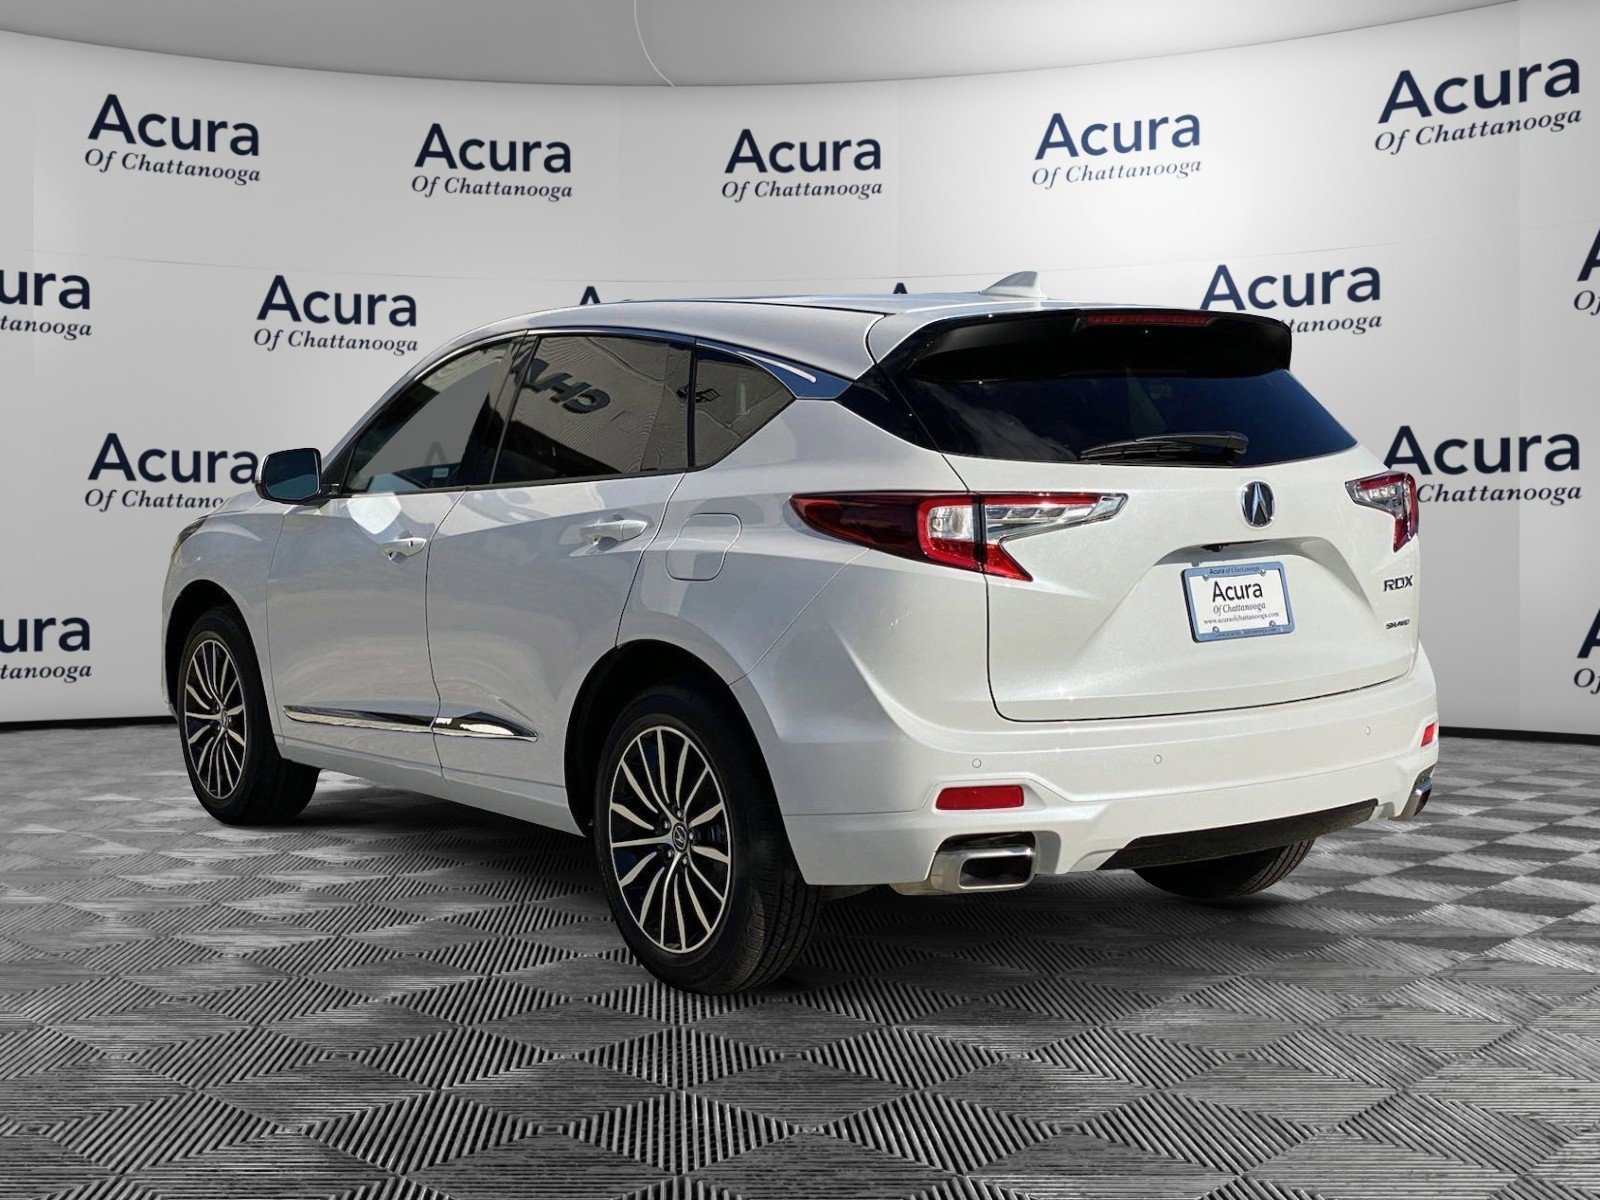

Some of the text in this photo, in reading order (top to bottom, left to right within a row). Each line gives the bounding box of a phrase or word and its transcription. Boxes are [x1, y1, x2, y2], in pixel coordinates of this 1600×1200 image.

[1378, 58, 1581, 125] Acura
[87, 93, 260, 157] Acura
[1034, 113, 1201, 160] Acura
[1375, 110, 1583, 155] Of Chattanooga
[414, 123, 572, 174] Acura
[724, 129, 882, 174] Acura
[85, 148, 261, 187] Of Chattanooga
[1031, 161, 1202, 190] Of Chattanooga
[411, 175, 573, 202] Of Chattanooga
[721, 181, 883, 203] Of Chattanooga
[0, 269, 90, 310] ura
[256, 275, 418, 327] Acura
[1200, 264, 1381, 311] Acura
[0, 315, 93, 341] tanooga
[254, 328, 419, 357] Of Chattanooga
[1288, 315, 1383, 335] tanooga
[87, 433, 259, 484] Acura
[1383, 425, 1581, 475] Acura
[85, 489, 224, 513] Of Chattano
[1416, 483, 1583, 506] Chattanooga
[1212, 581, 1263, 602] Acura
[1383, 574, 1413, 593] RDX
[1213, 602, 1266, 617] Of Chattanooga
[0, 617, 90, 653] ura
[0, 664, 93, 684] tanooga
